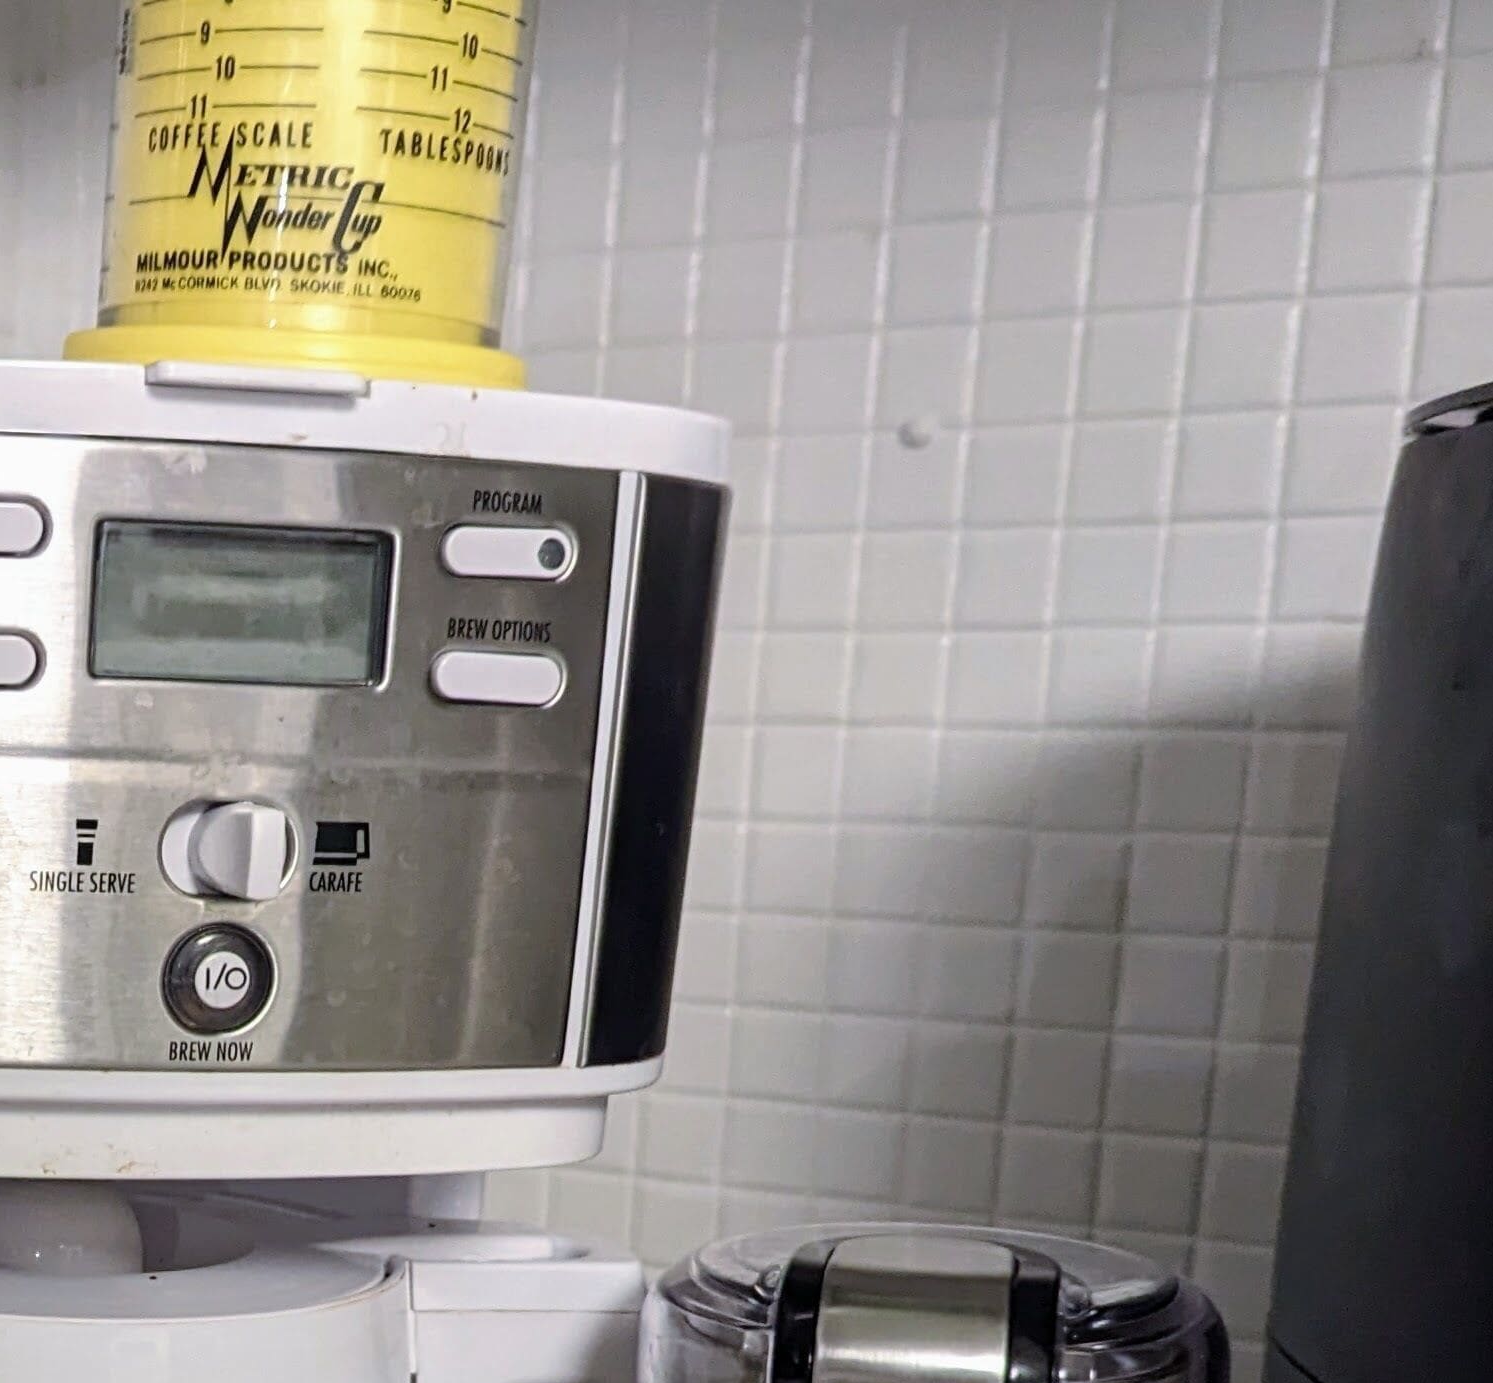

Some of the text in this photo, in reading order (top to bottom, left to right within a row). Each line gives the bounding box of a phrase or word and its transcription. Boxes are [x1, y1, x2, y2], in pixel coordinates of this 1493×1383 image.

[200, 20, 211, 45] 9
[461, 31, 479, 60] 10
[215, 54, 236, 81] 10
[430, 64, 449, 91] 11
[190, 94, 208, 119] 11
[453, 107, 472, 135] 12
[148, 121, 315, 152] COFFEE SCALE
[379, 128, 510, 176] TABLESPOONS
[136, 248, 219, 273] MILMOUR
[227, 250, 349, 275] PRODUCTS
[472, 490, 543, 515] PROGRAM
[446, 617, 552, 644] BREW OPTIONS
[29, 871, 137, 894] SINGLE SERVE
[308, 871, 363, 893] CARAFE
[168, 1041, 254, 1062] BREW NOW
